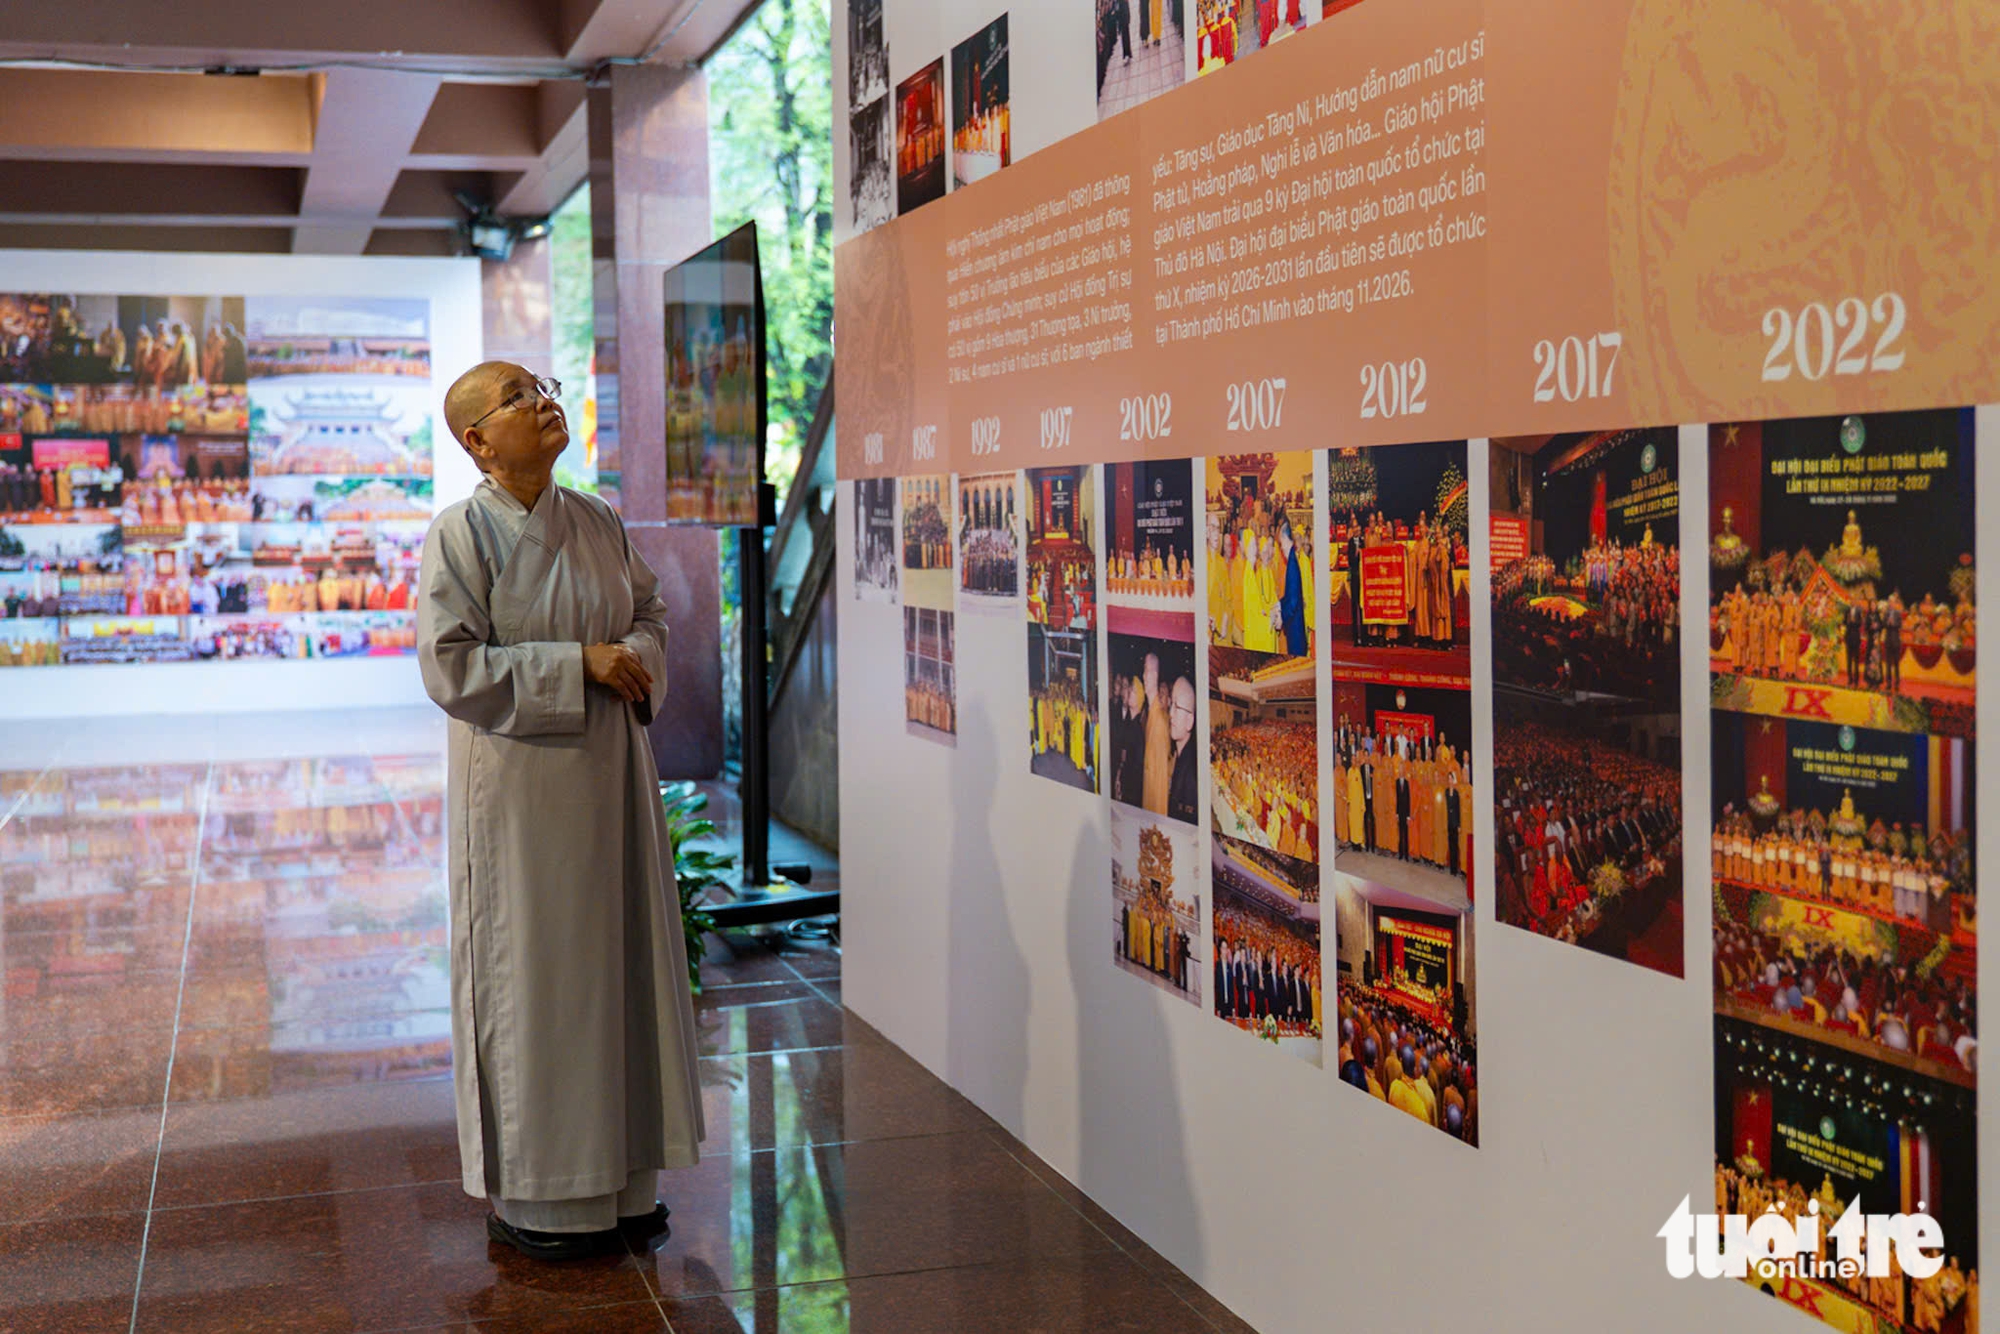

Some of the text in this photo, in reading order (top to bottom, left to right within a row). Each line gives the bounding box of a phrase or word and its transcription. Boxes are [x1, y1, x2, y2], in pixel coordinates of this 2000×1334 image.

[1315, 86, 1358, 120] Hướng
[1360, 68, 1387, 102] dẫn
[1390, 62, 1421, 92] nam
[1424, 47, 1445, 79] nữ
[1447, 41, 1468, 70] cư
[1471, 31, 1485, 60] sĩ
[1318, 129, 1344, 156] Văn
[1346, 119, 1381, 148] hóa...
[1384, 103, 1418, 134] Giáo
[1421, 90, 1444, 124] hội
[1448, 78, 1485, 113] Phật
[1313, 169, 1333, 200] hội
[1335, 163, 1364, 191] toàn
[1367, 145, 1402, 186] quốc
[1405, 134, 1420, 170] tổ
[1423, 131, 1461, 164] chức
[1464, 120, 1485, 155] tại
[1318, 206, 1348, 235] Phật
[1350, 197, 1380, 232] giáo
[1382, 188, 1415, 217] toàn
[1418, 171, 1457, 213] quốc
[1462, 164, 1485, 196] lần
[1120, 234, 1132, 258] hệ
[1315, 244, 1339, 274] đầu
[1341, 242, 1367, 268] tiên
[1369, 235, 1386, 262] sẽ
[1388, 230, 1425, 259] được
[1427, 213, 1444, 248] tổ
[1446, 212, 1487, 244] chức
[1120, 269, 1132, 290] sự
[1317, 286, 1354, 313] tháng
[1357, 270, 1414, 304] 11.2026.
[1762, 293, 1906, 381] 2022
[1360, 358, 1426, 418] 2012
[1534, 332, 1622, 402] 2017
[1041, 407, 1072, 448] 1997
[1120, 393, 1171, 440] 2002
[1227, 378, 1286, 431] 2007
[913, 425, 937, 460] 1987
[972, 417, 1000, 454] 1992
[1782, 687, 1833, 720] IX
[1802, 906, 1835, 931] IX
